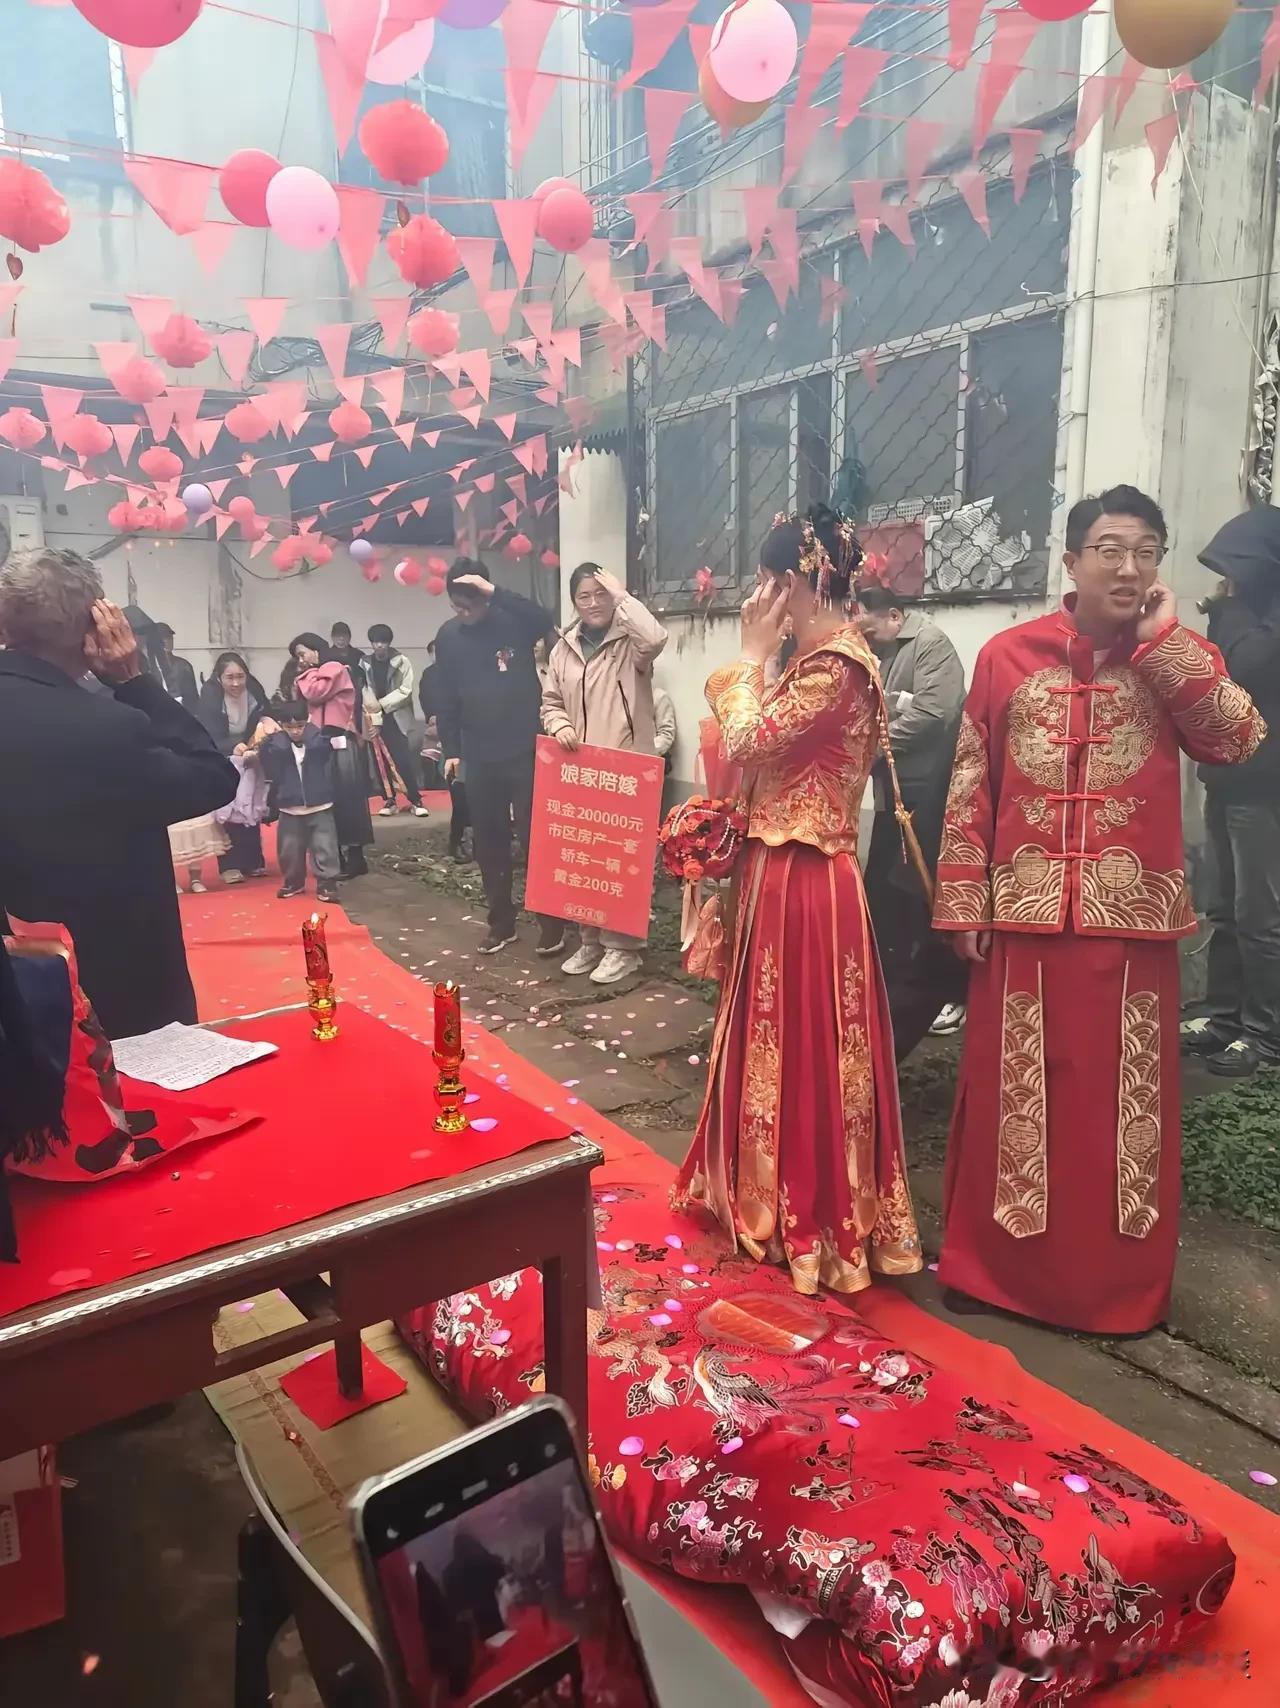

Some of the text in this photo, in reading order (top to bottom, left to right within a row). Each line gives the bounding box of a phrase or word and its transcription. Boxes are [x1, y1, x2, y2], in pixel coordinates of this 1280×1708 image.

[561, 762, 637, 796] 娘家陪嫁
[546, 799, 643, 833] 现金200000元
[549, 823, 639, 854] 市区房产一套
[561, 848, 621, 874] 轿车一辆
[553, 868, 623, 897] 黄金200克
